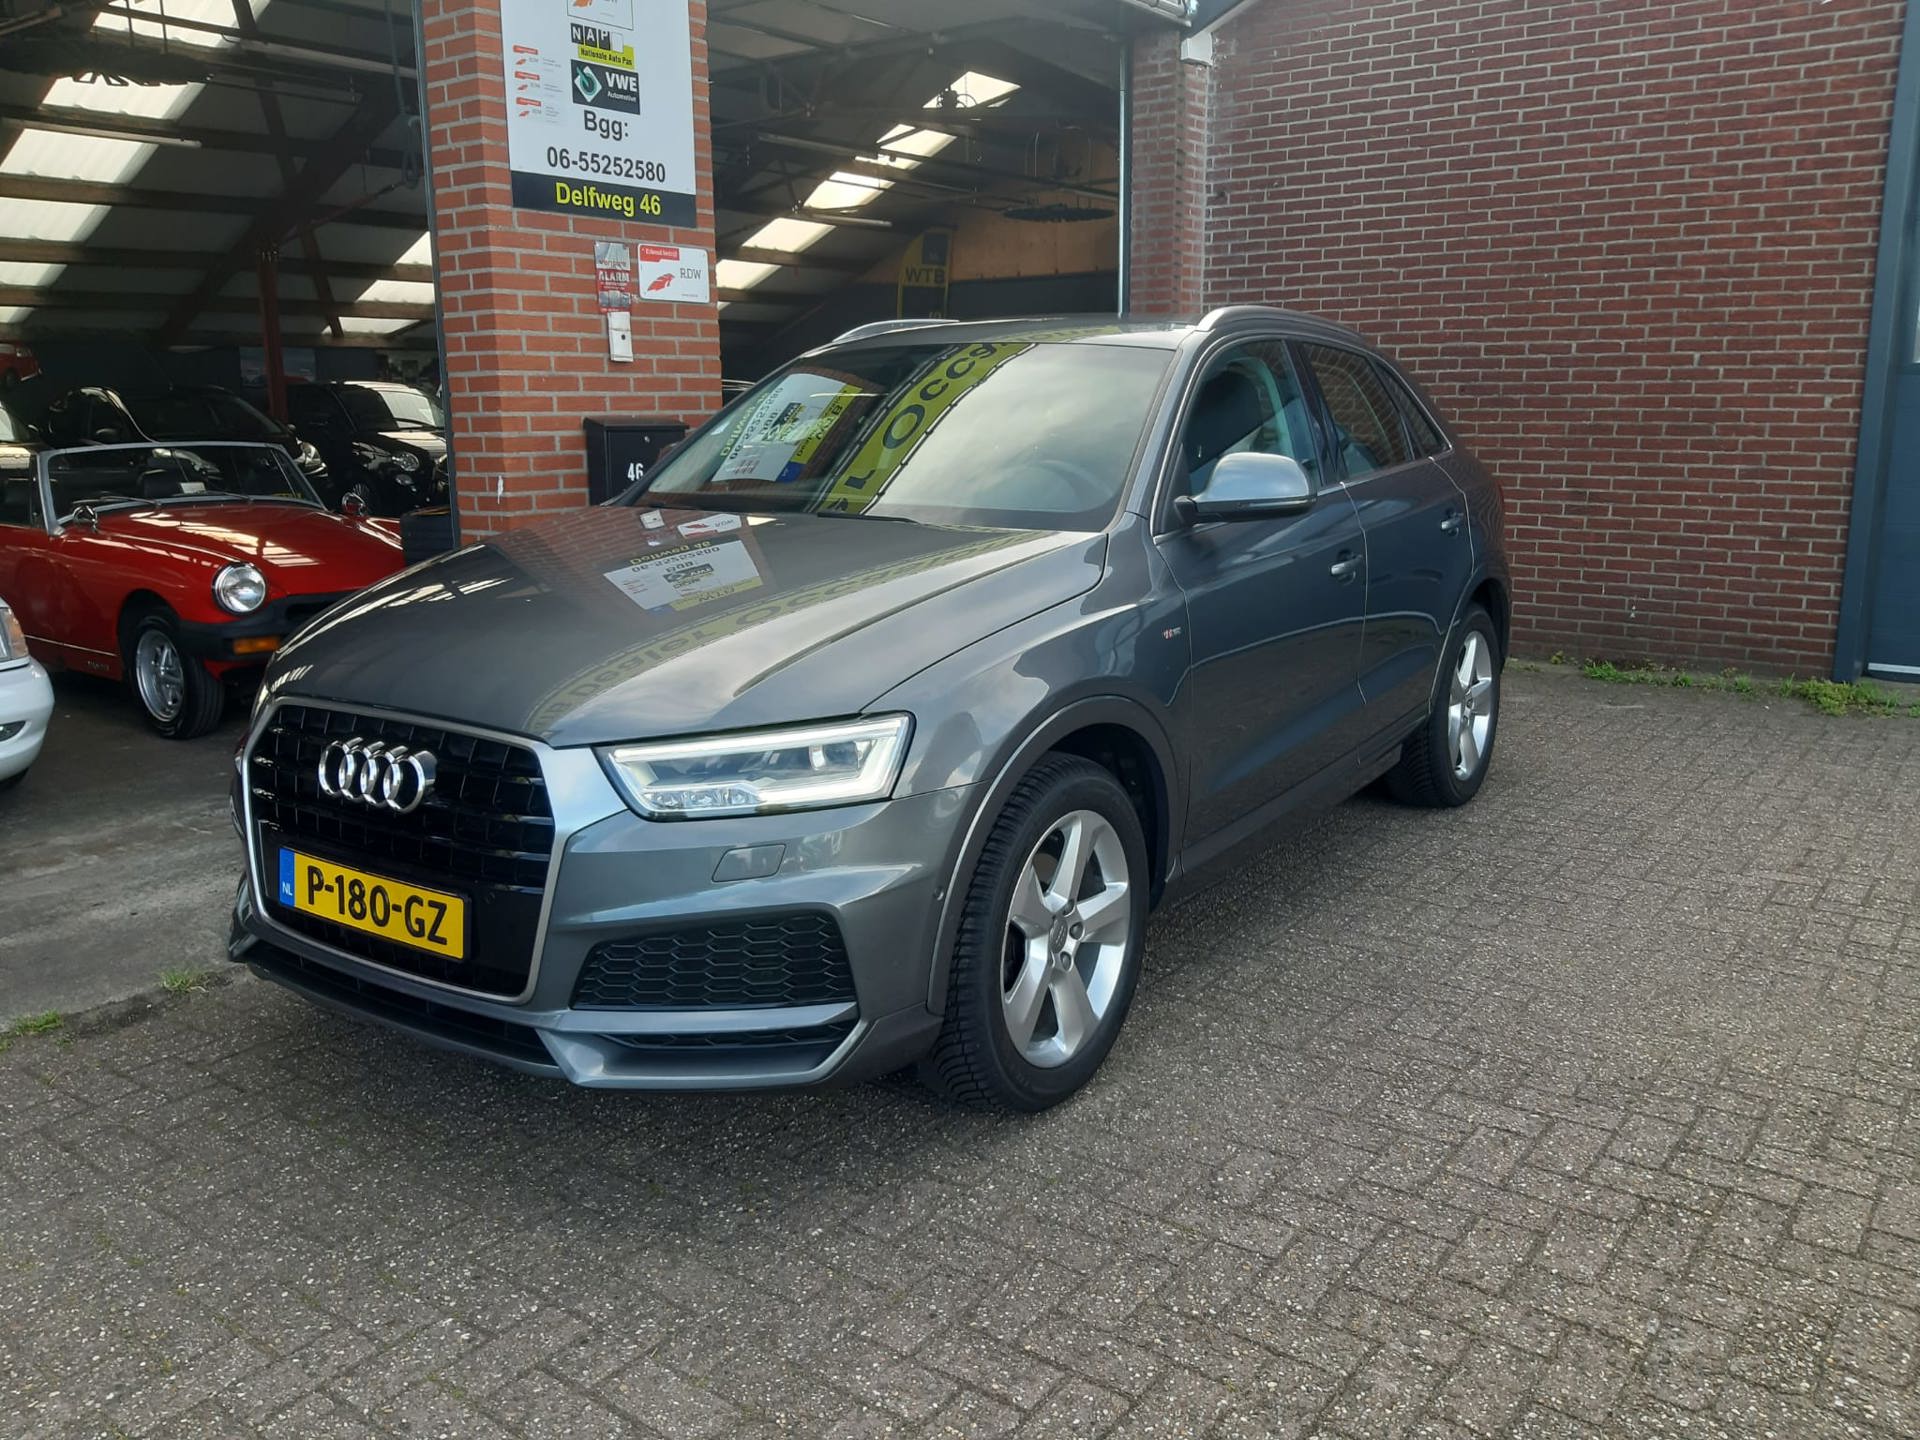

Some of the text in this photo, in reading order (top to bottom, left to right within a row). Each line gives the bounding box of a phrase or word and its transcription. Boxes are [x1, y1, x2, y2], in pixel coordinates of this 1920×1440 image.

[572, 26, 608, 41] NAP
[581, 48, 607, 61] Nationale
[608, 55, 621, 63] Auto
[605, 71, 637, 92] VWE
[607, 91, 636, 102] Automotive
[583, 109, 629, 141] Bgg:
[547, 146, 666, 183] 06-55252580
[555, 182, 661, 218] Delfweg 46
[599, 270, 629, 282] ALARM
[680, 267, 702, 280] RDW
[905, 266, 946, 284] WTB
[627, 462, 643, 481] 46
[282, 865, 447, 945] NL P-180-GZ
